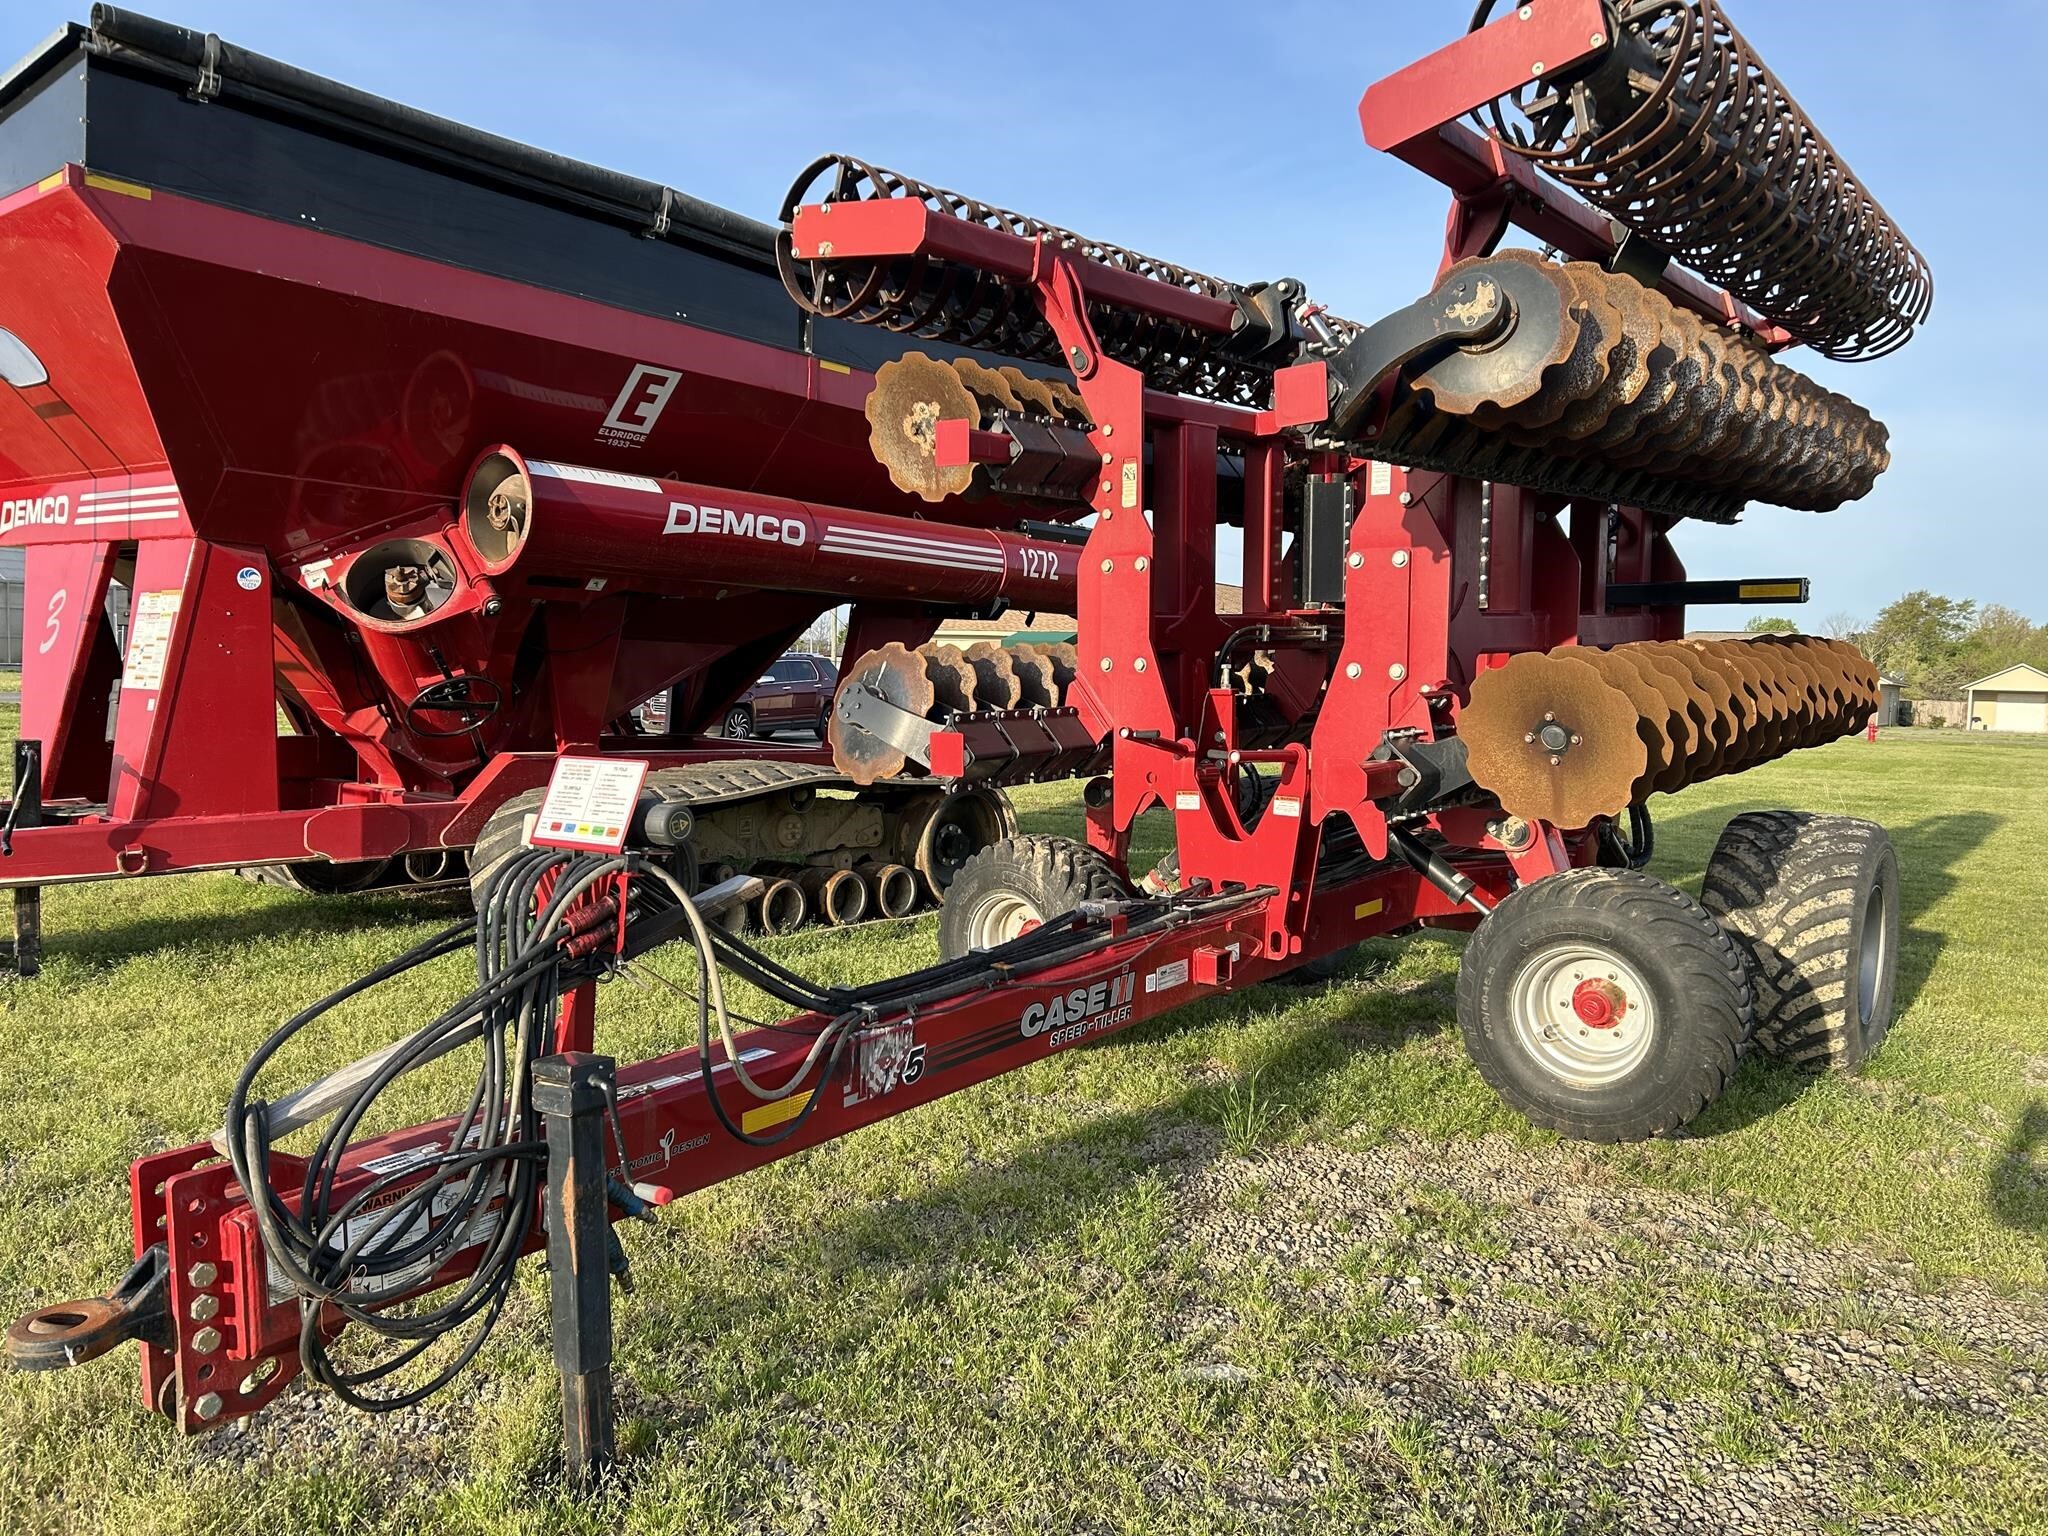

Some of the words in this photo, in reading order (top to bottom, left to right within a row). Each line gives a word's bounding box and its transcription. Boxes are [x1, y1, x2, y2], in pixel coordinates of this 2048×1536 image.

[597, 427, 647, 442] ELDRIDGE
[606, 438, 631, 449] 1933
[0, 495, 69, 537] DEMCO
[662, 501, 806, 547] DEMCO
[1019, 547, 1059, 581] 1272
[39, 588, 67, 655] 3
[1020, 980, 1108, 1039] CASE
[1048, 1004, 1133, 1048] SPEED-TILLER
[901, 1042, 928, 1086] 5
[671, 1133, 711, 1156] DESIGN
